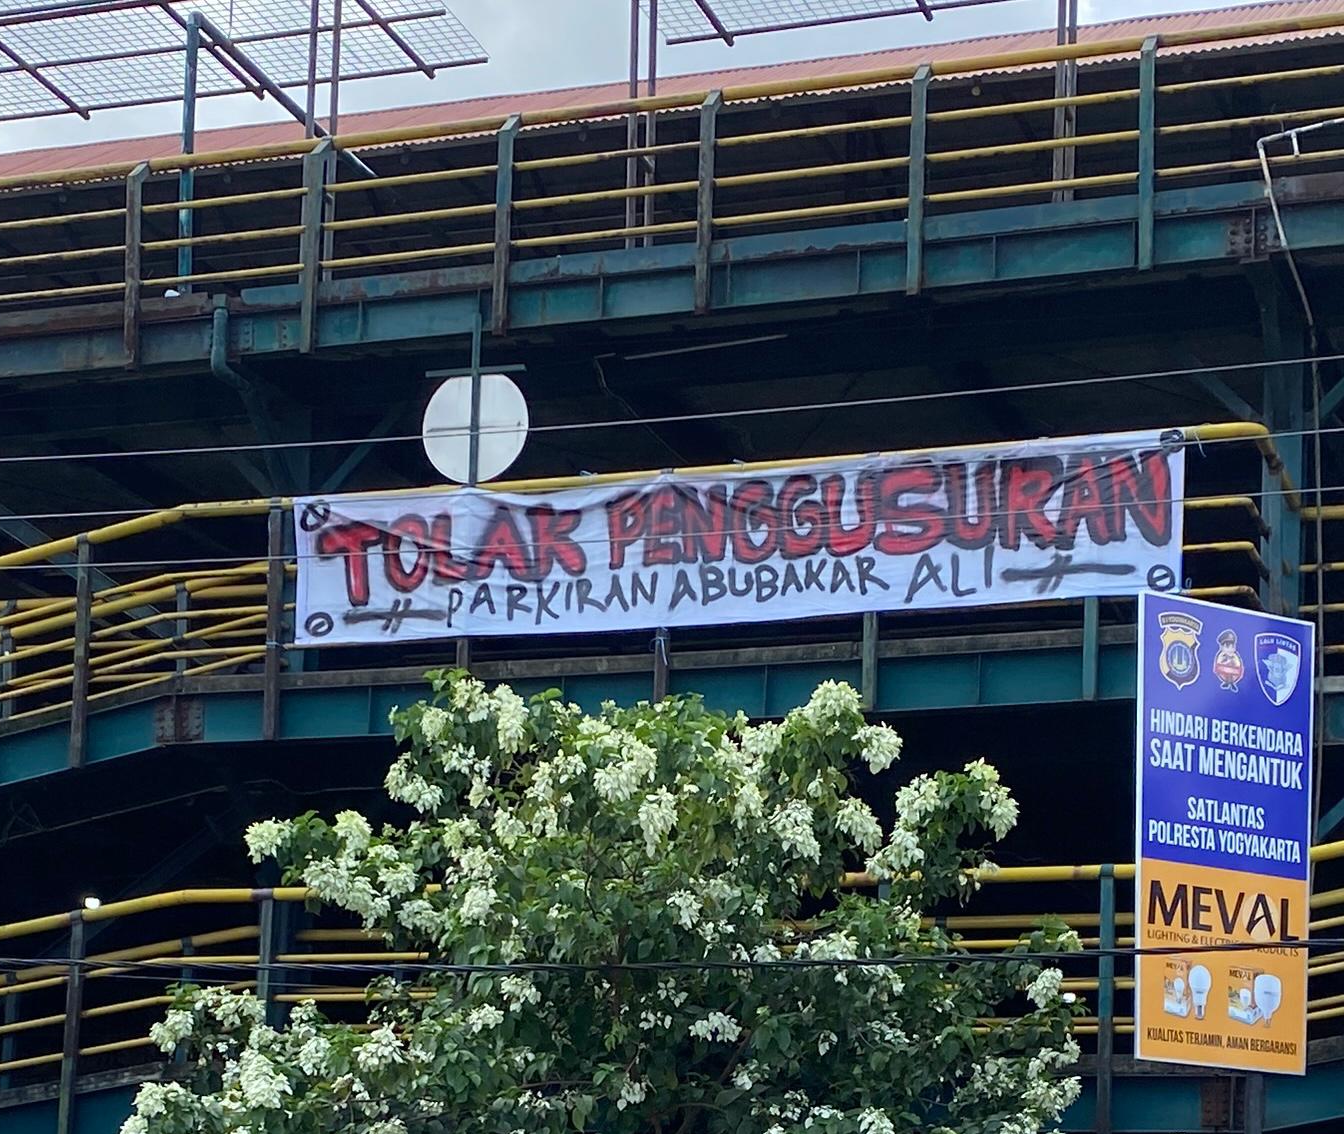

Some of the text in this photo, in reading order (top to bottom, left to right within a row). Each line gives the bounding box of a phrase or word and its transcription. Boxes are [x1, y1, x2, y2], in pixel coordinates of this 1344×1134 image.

[316, 449, 1172, 608] TOLAK PENGGUSURAN
[447, 545, 994, 628] PARKIRAN ABUBAKAR ALI
[1150, 708, 1303, 757] HINDARI BERKENDARA
[1150, 738, 1303, 790] SAAT MENGANTUK
[1187, 796, 1265, 830] SATLANTAS
[1148, 819, 1301, 863] POLRESTA YOGYAKARTA
[1147, 880, 1300, 942] MEVAL
[1147, 930, 1191, 944] LIGHTING
[1191, 936, 1199, 945] &
[1147, 1027, 1184, 1043] KUALITAS
[1226, 1036, 1249, 1051] AMAN
[1250, 1039, 1297, 1056] BERGARANSI
